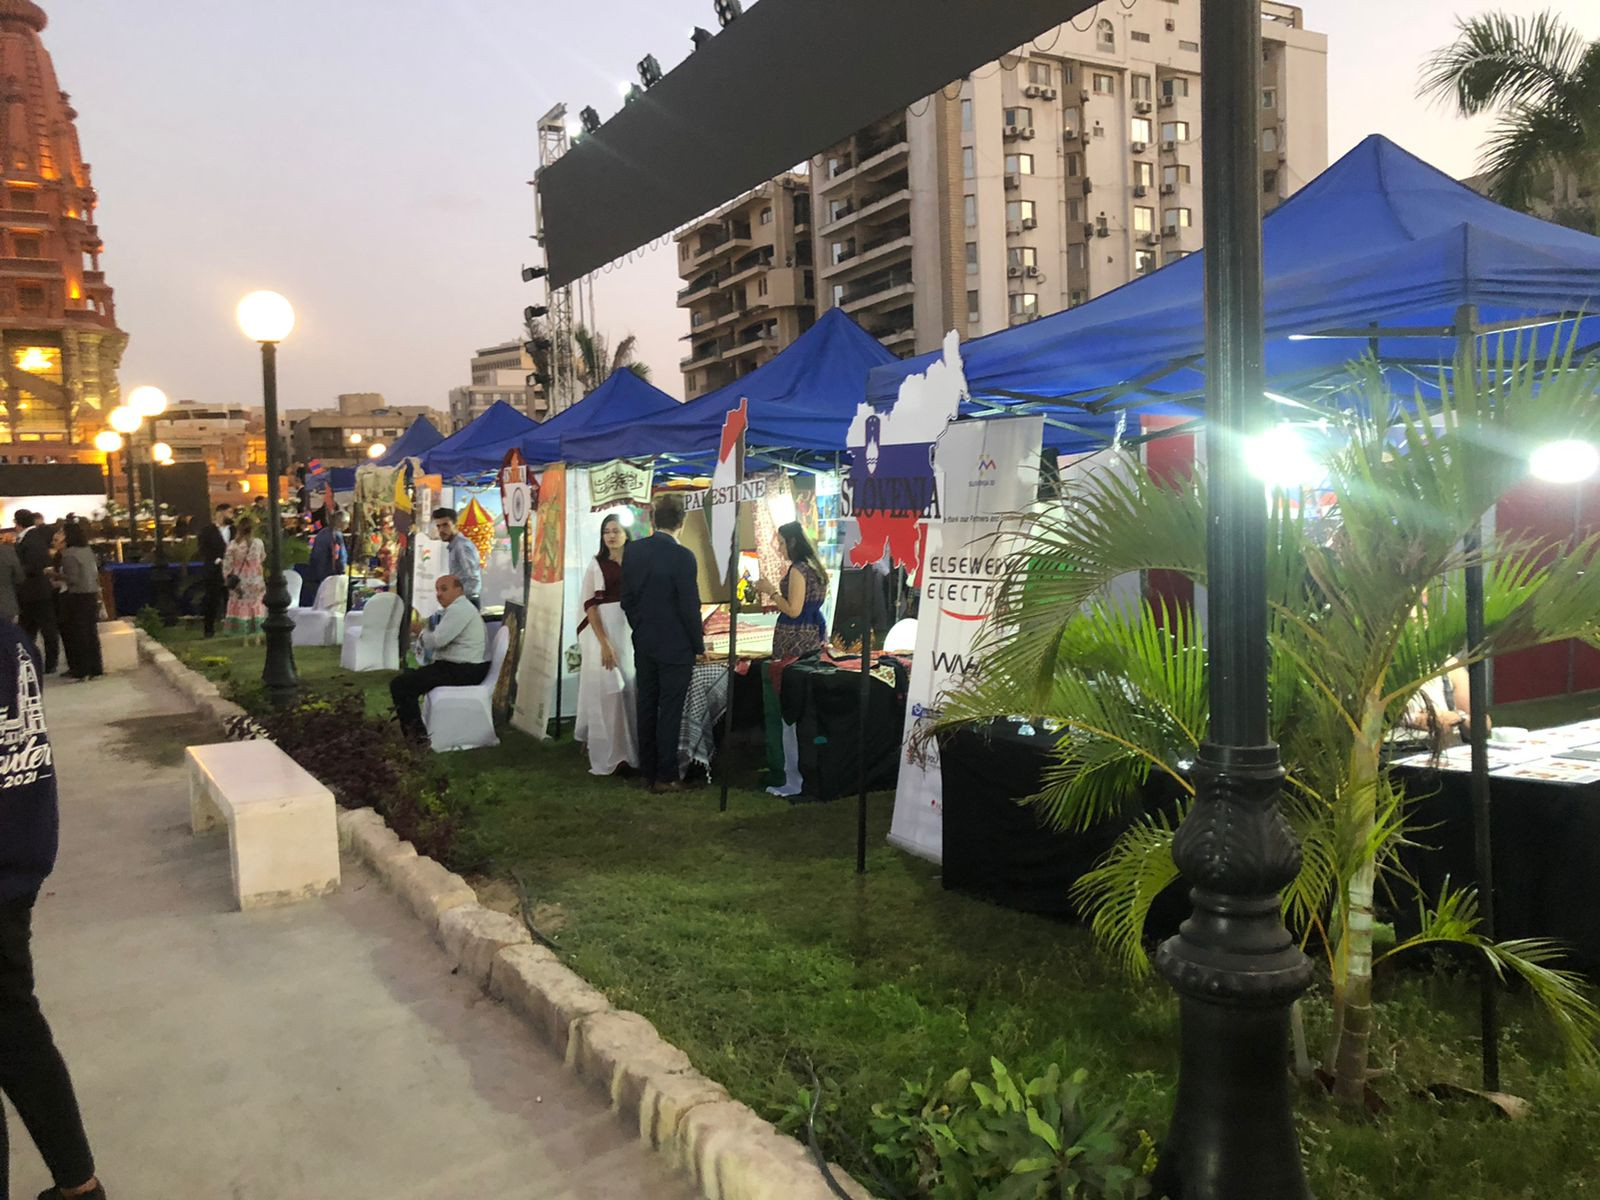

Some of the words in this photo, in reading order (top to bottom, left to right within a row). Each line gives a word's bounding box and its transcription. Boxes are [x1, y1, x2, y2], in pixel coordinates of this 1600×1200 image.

[684, 480, 766, 510] PALESTINE
[841, 476, 941, 519] SLOVENIA
[926, 582, 996, 603] ELECTR
[2, 771, 38, 789] 2021
